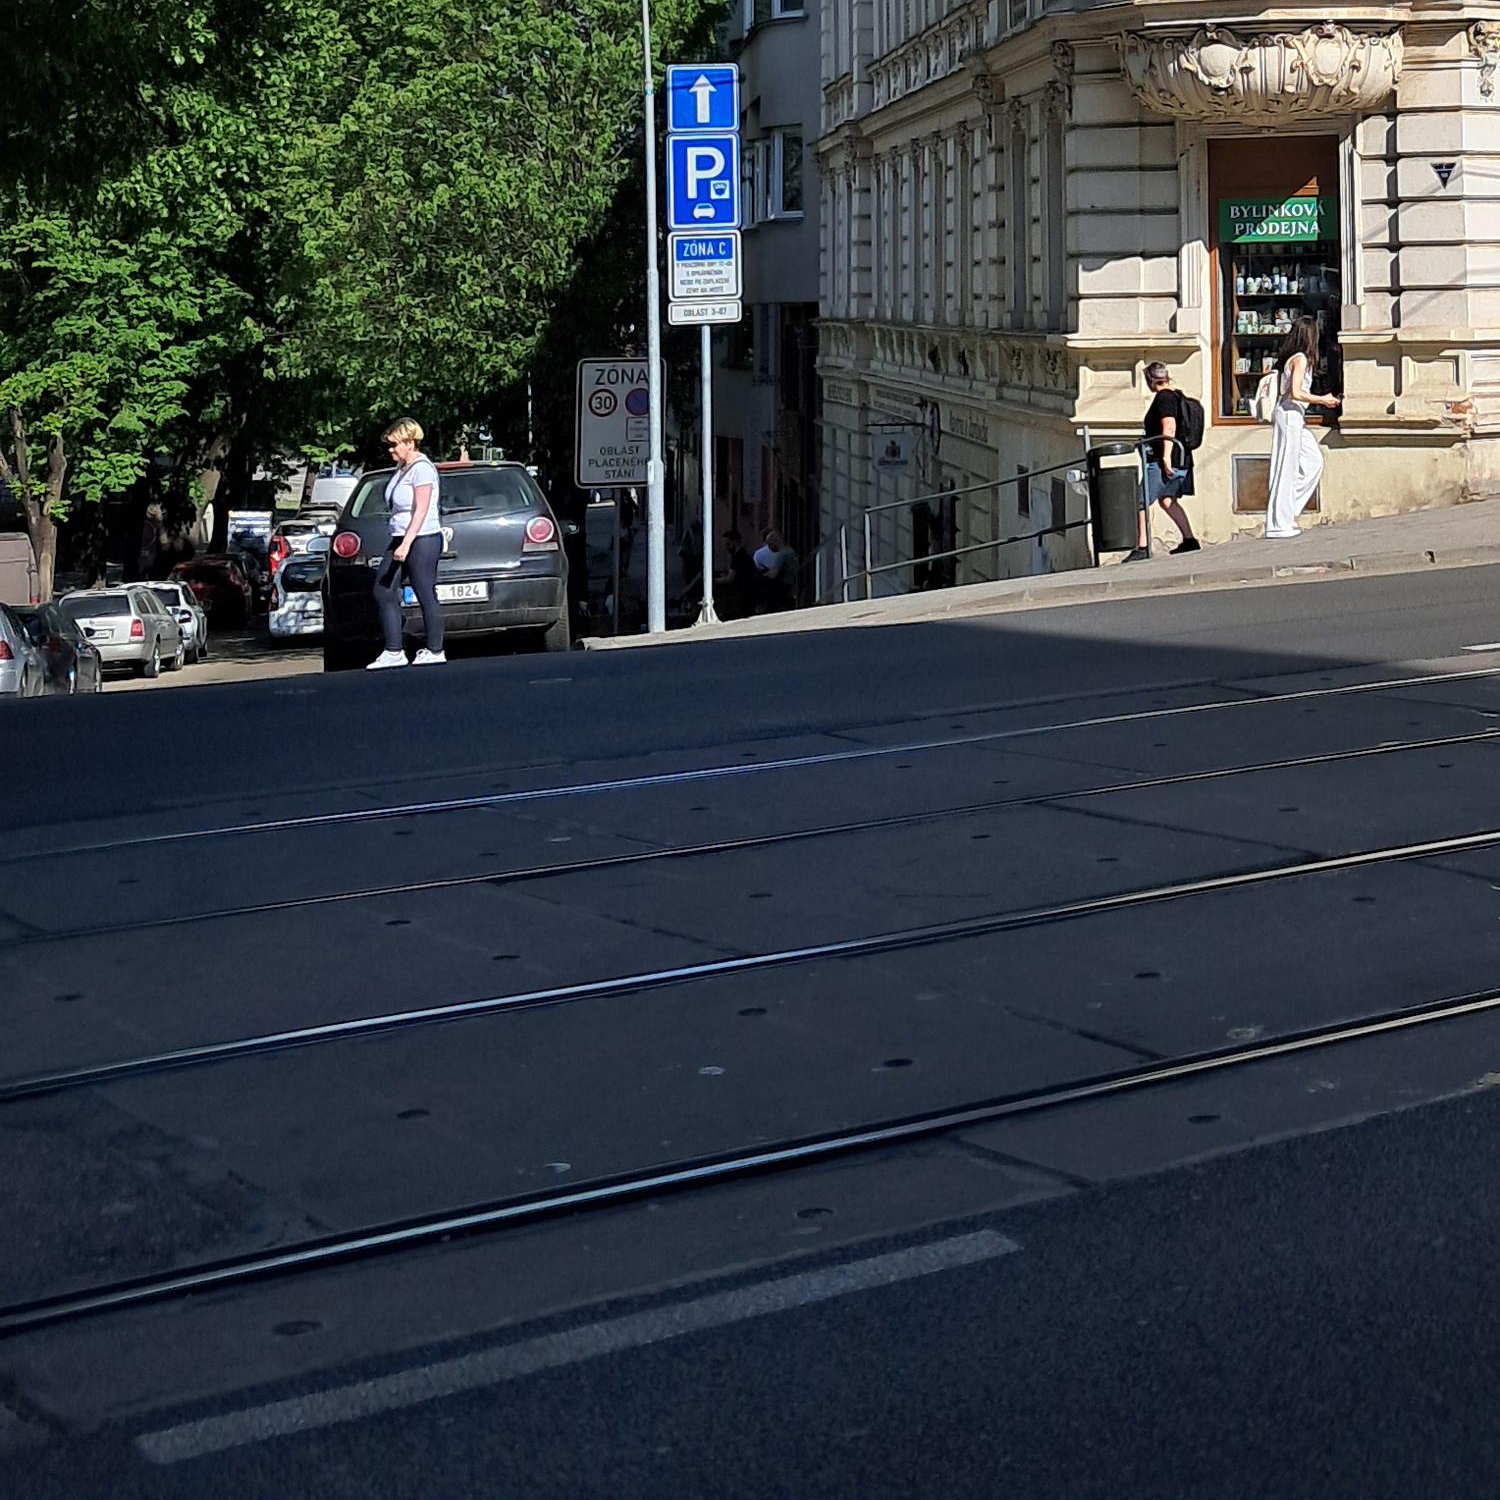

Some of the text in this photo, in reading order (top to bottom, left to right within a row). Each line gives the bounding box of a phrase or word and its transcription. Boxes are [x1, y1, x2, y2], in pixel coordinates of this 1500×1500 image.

[687, 146, 725, 199] P
[1230, 200, 1325, 218] BYLINKOVÁ
[1234, 221, 1320, 237] PRODEJNA
[683, 240, 726, 257] ZÓNA C
[595, 365, 649, 386] ZÓNA
[594, 396, 612, 410] 30
[600, 446, 640, 456] OBLAST
[588, 457, 649, 468] PLACENÉH
[604, 468, 634, 479] STÁNÍ
[449, 584, 480, 597] 1824
